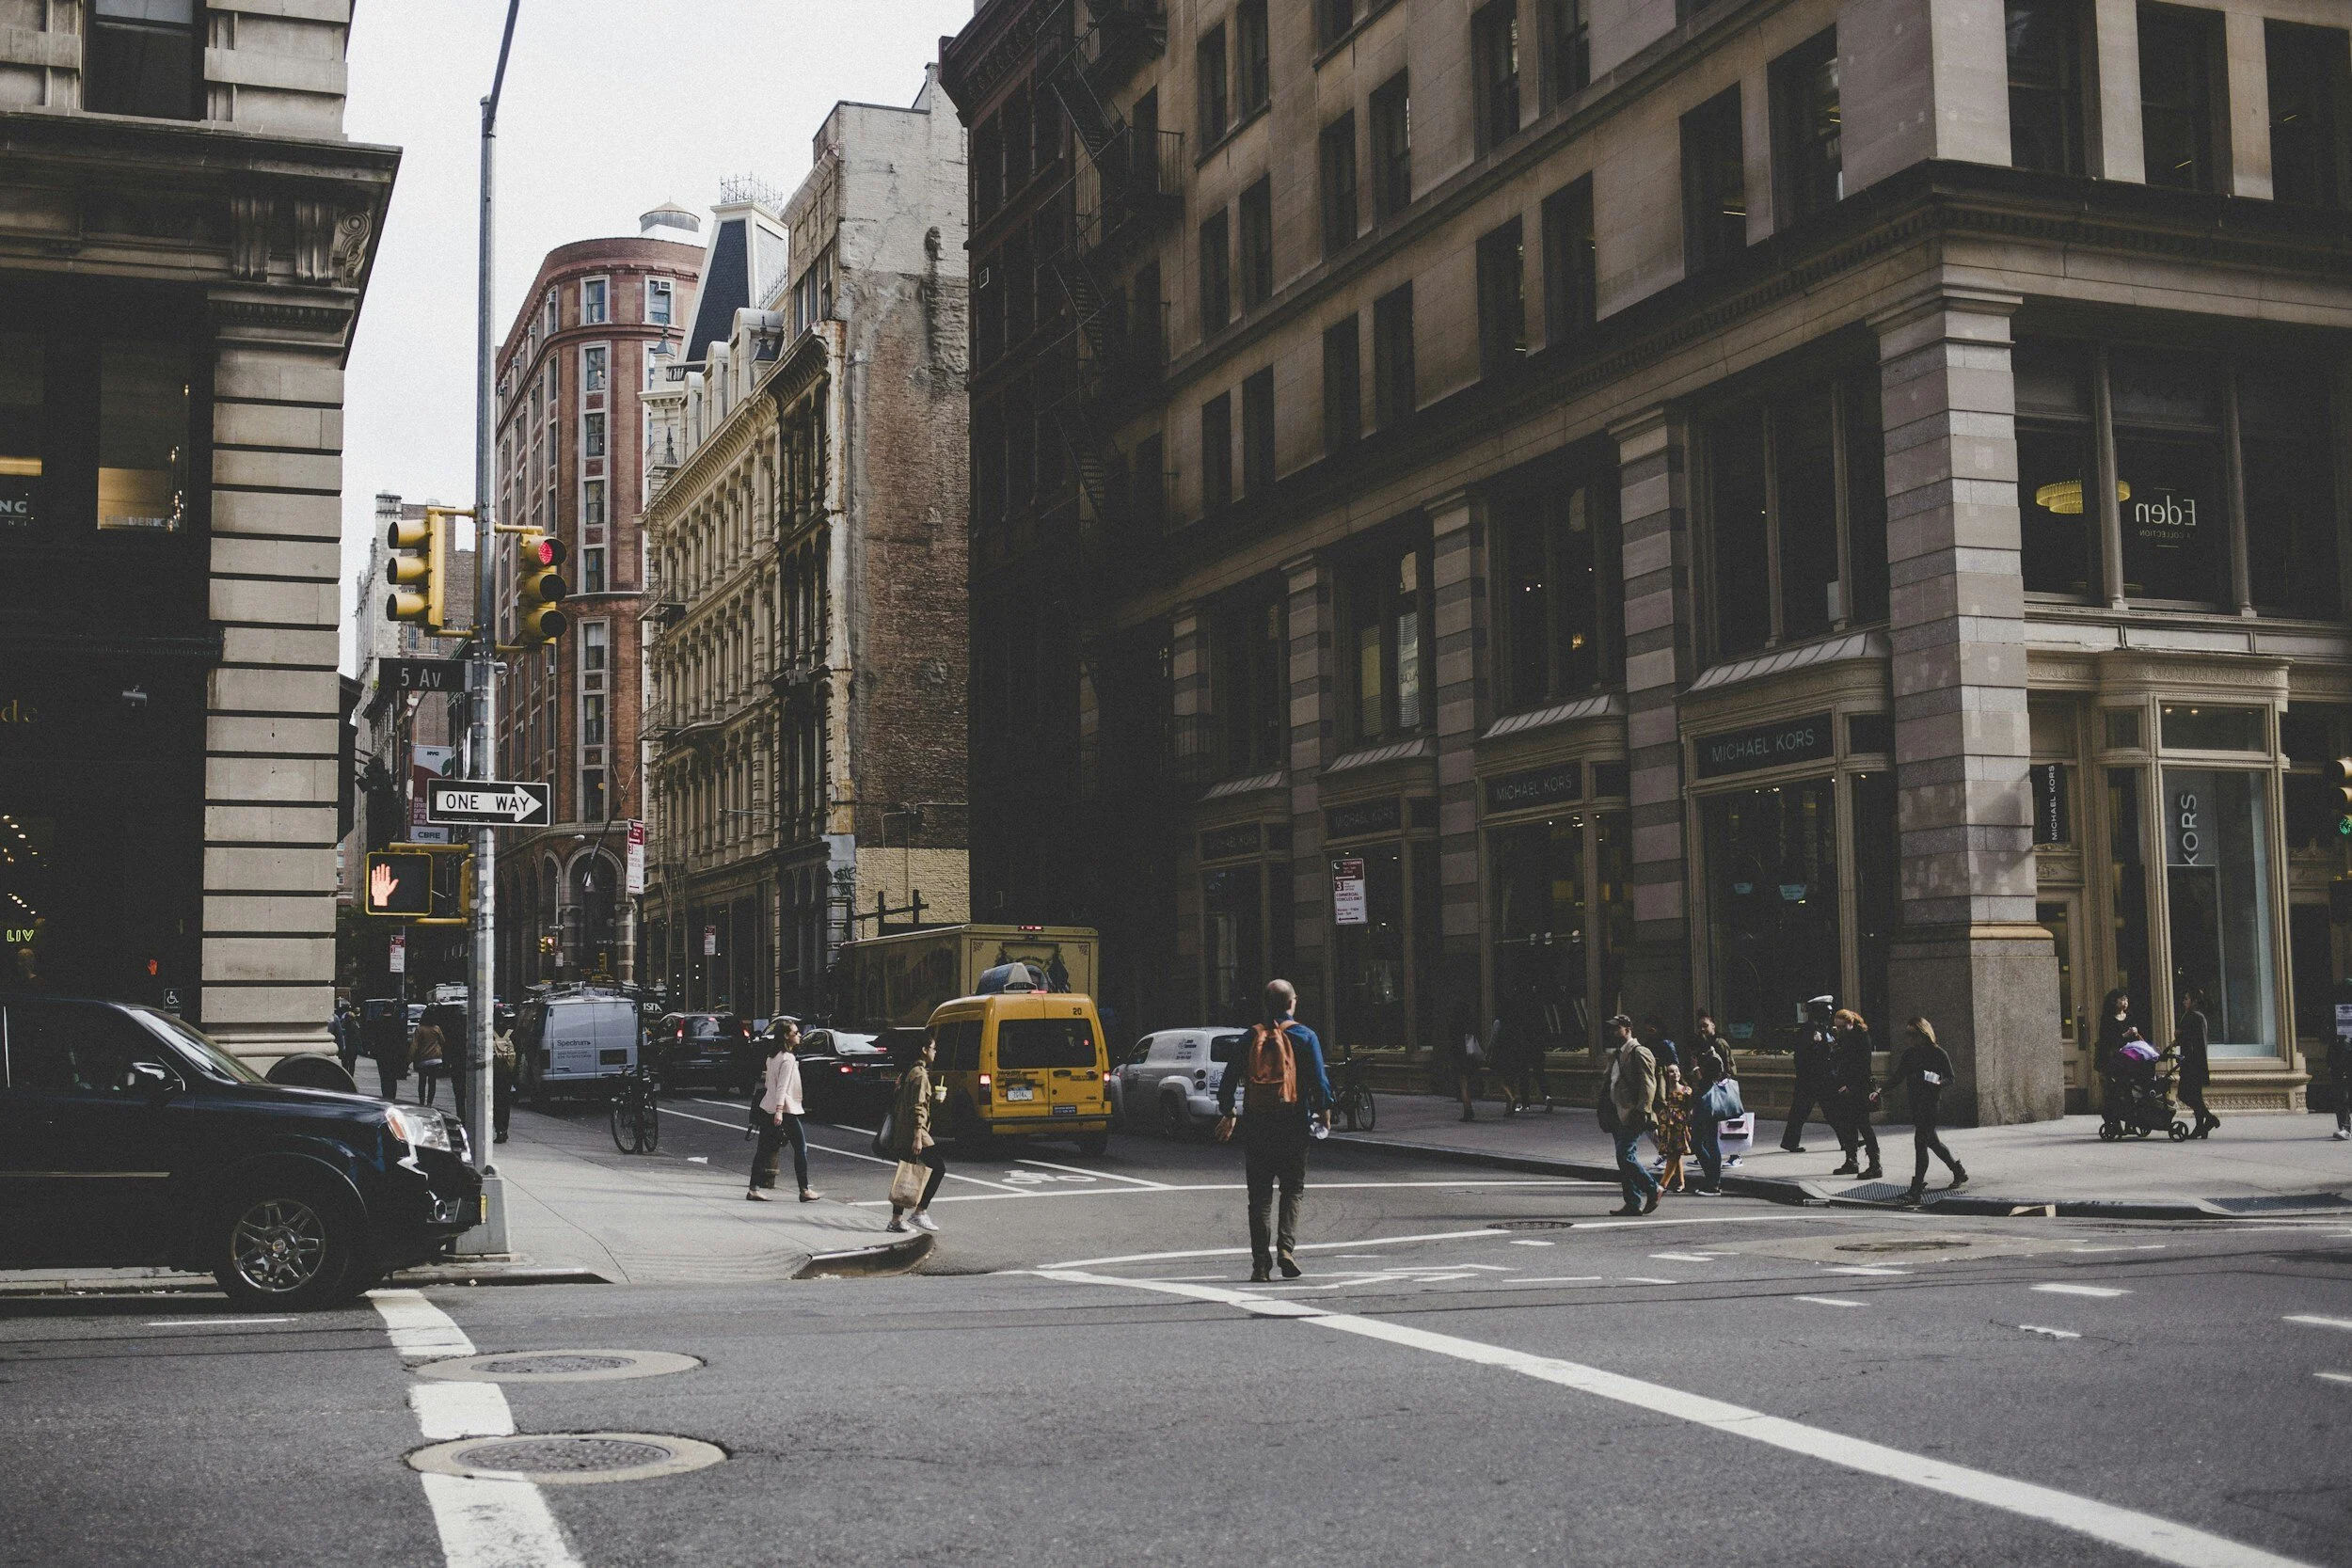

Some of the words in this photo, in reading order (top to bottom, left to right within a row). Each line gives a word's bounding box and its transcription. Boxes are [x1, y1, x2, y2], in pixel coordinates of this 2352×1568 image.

[401, 667, 410, 687] 5
[419, 668, 441, 688] Av
[1712, 736, 1769, 762] MICHAEL
[1776, 728, 1814, 751] KORS
[1497, 781, 1540, 800] MICHAEL
[1544, 774, 1572, 792] KORS
[446, 793, 479, 810] ONE
[496, 796, 530, 812] WAY
[2049, 796, 2058, 841] MICHAEL
[2181, 794, 2200, 864] KORS
[1336, 881, 1343, 891] 3
[7, 929, 35, 942] LIV
